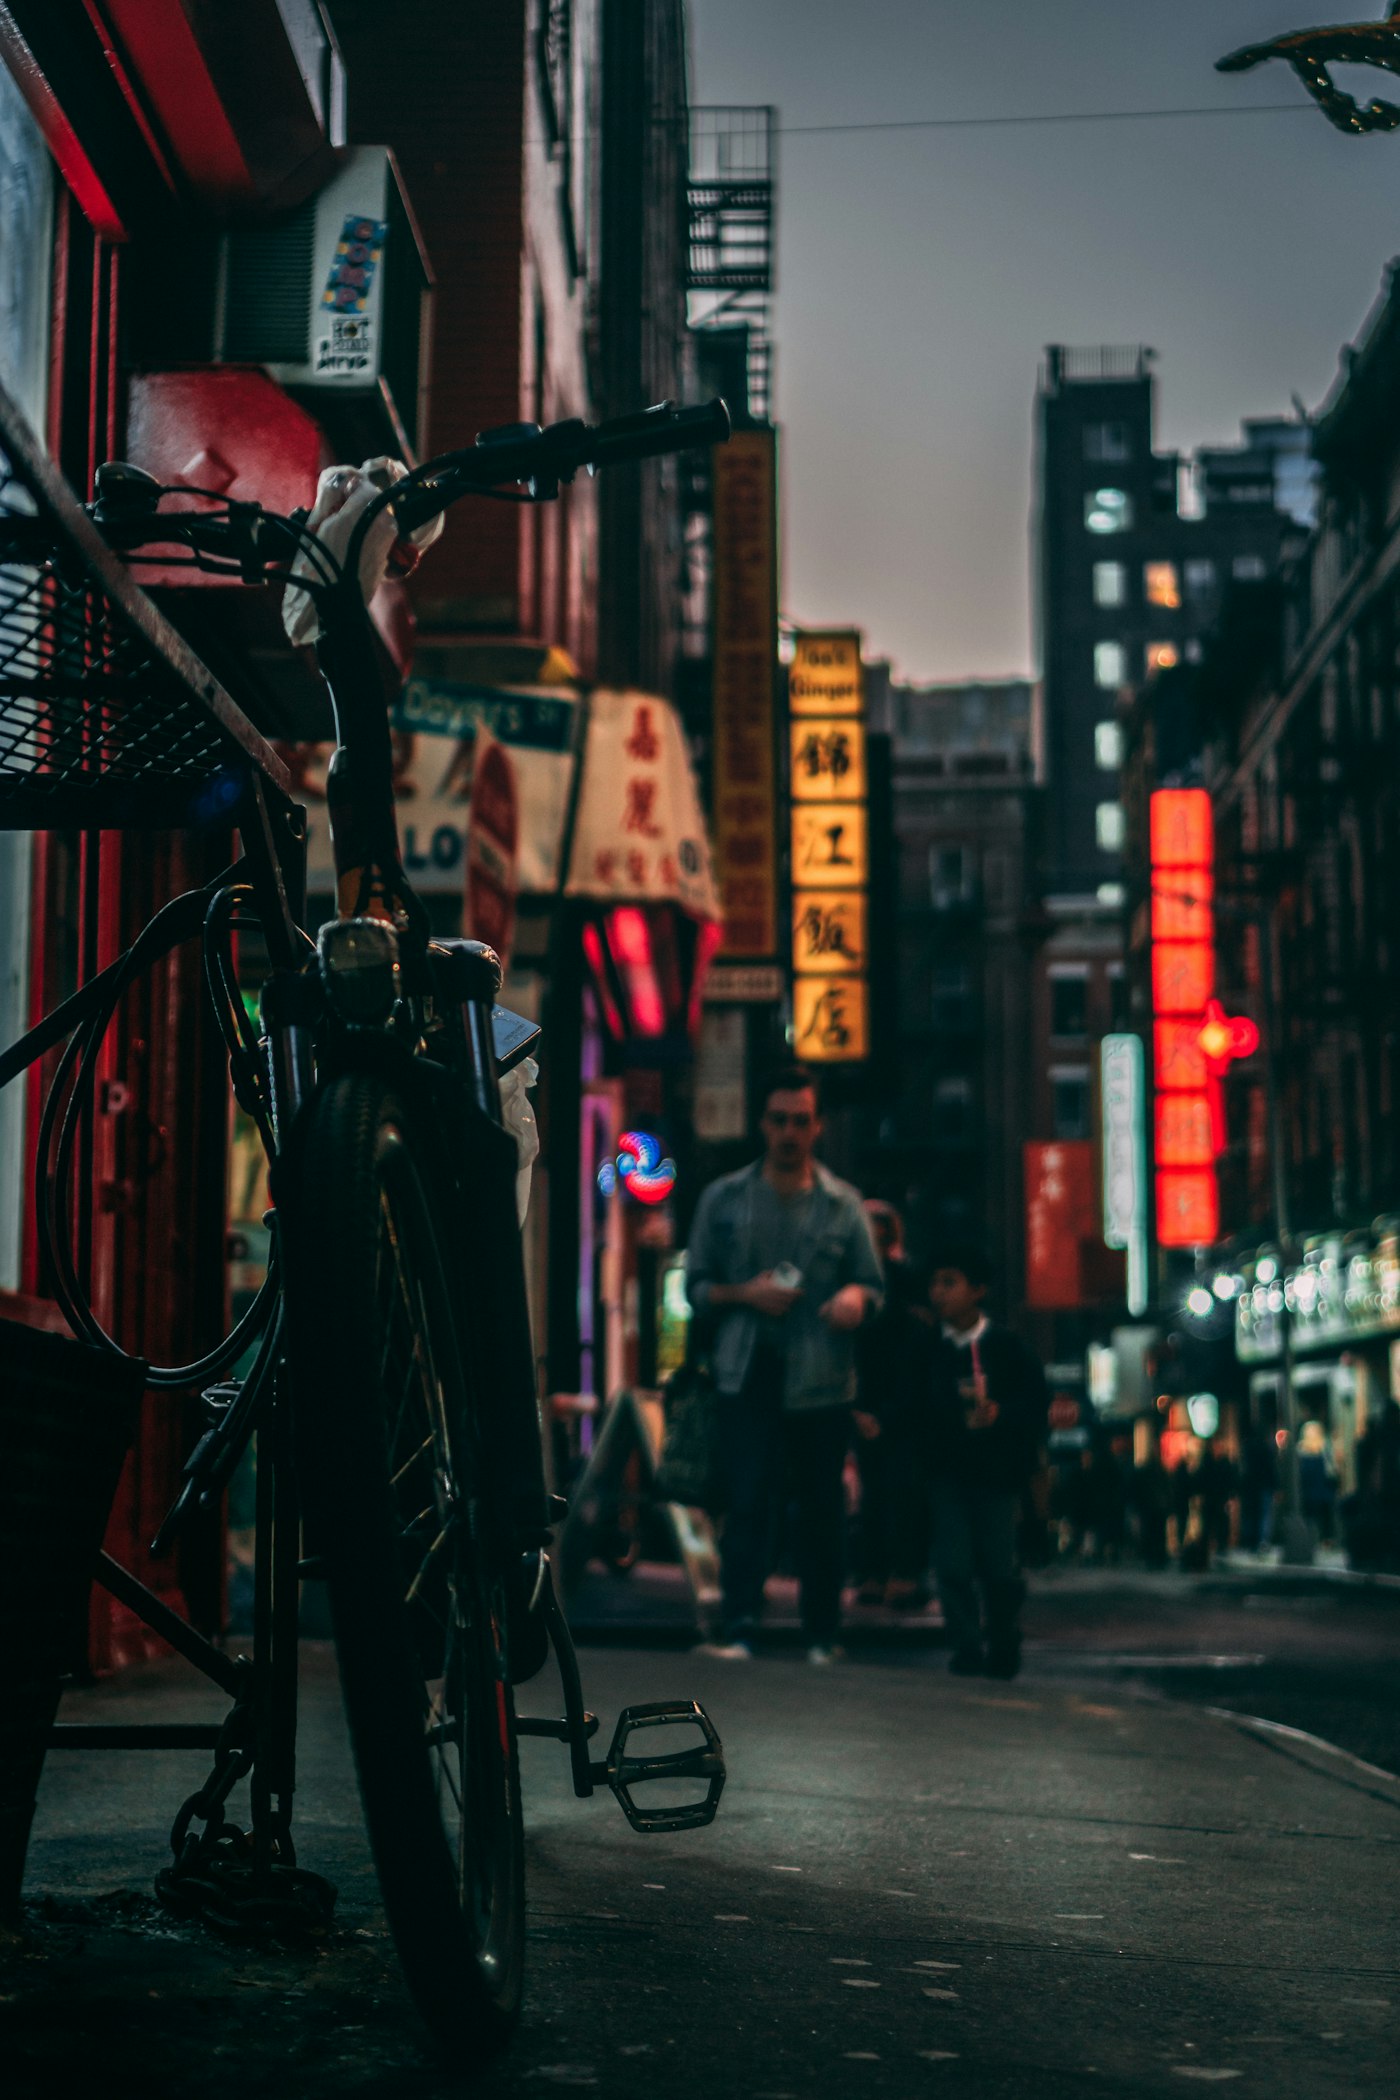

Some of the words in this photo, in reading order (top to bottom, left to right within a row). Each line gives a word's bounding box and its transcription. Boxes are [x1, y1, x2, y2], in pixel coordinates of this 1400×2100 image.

[790, 675, 855, 701] Ginger
[796, 730, 859, 1049] 錦江飯店
